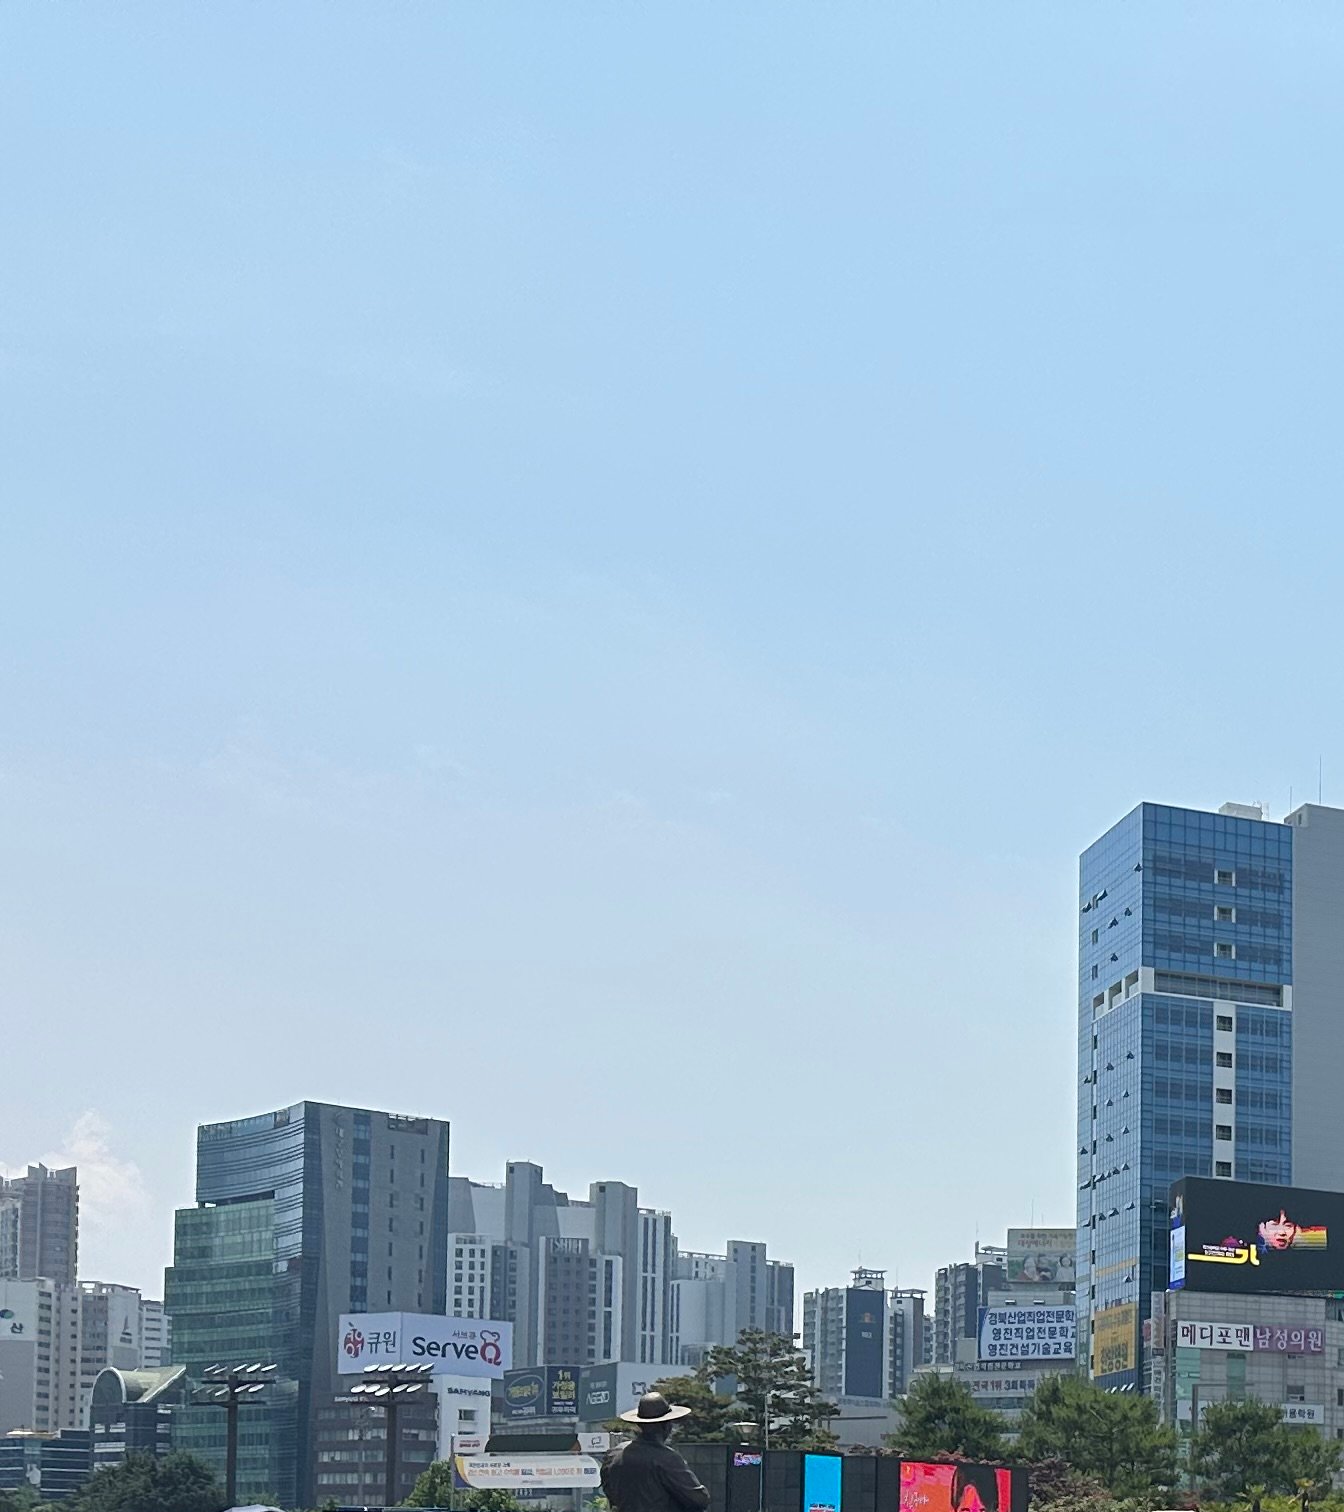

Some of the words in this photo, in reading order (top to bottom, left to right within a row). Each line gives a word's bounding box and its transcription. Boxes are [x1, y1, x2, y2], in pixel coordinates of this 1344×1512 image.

[988, 1311, 1075, 1326] 경북산업직업전문학
[367, 1331, 397, 1354] 큐원
[1181, 1323, 1250, 1348] 메디포맨
[1256, 1328, 1323, 1352] 남성의원
[988, 1341, 1074, 1356] 영진건설기술교육
